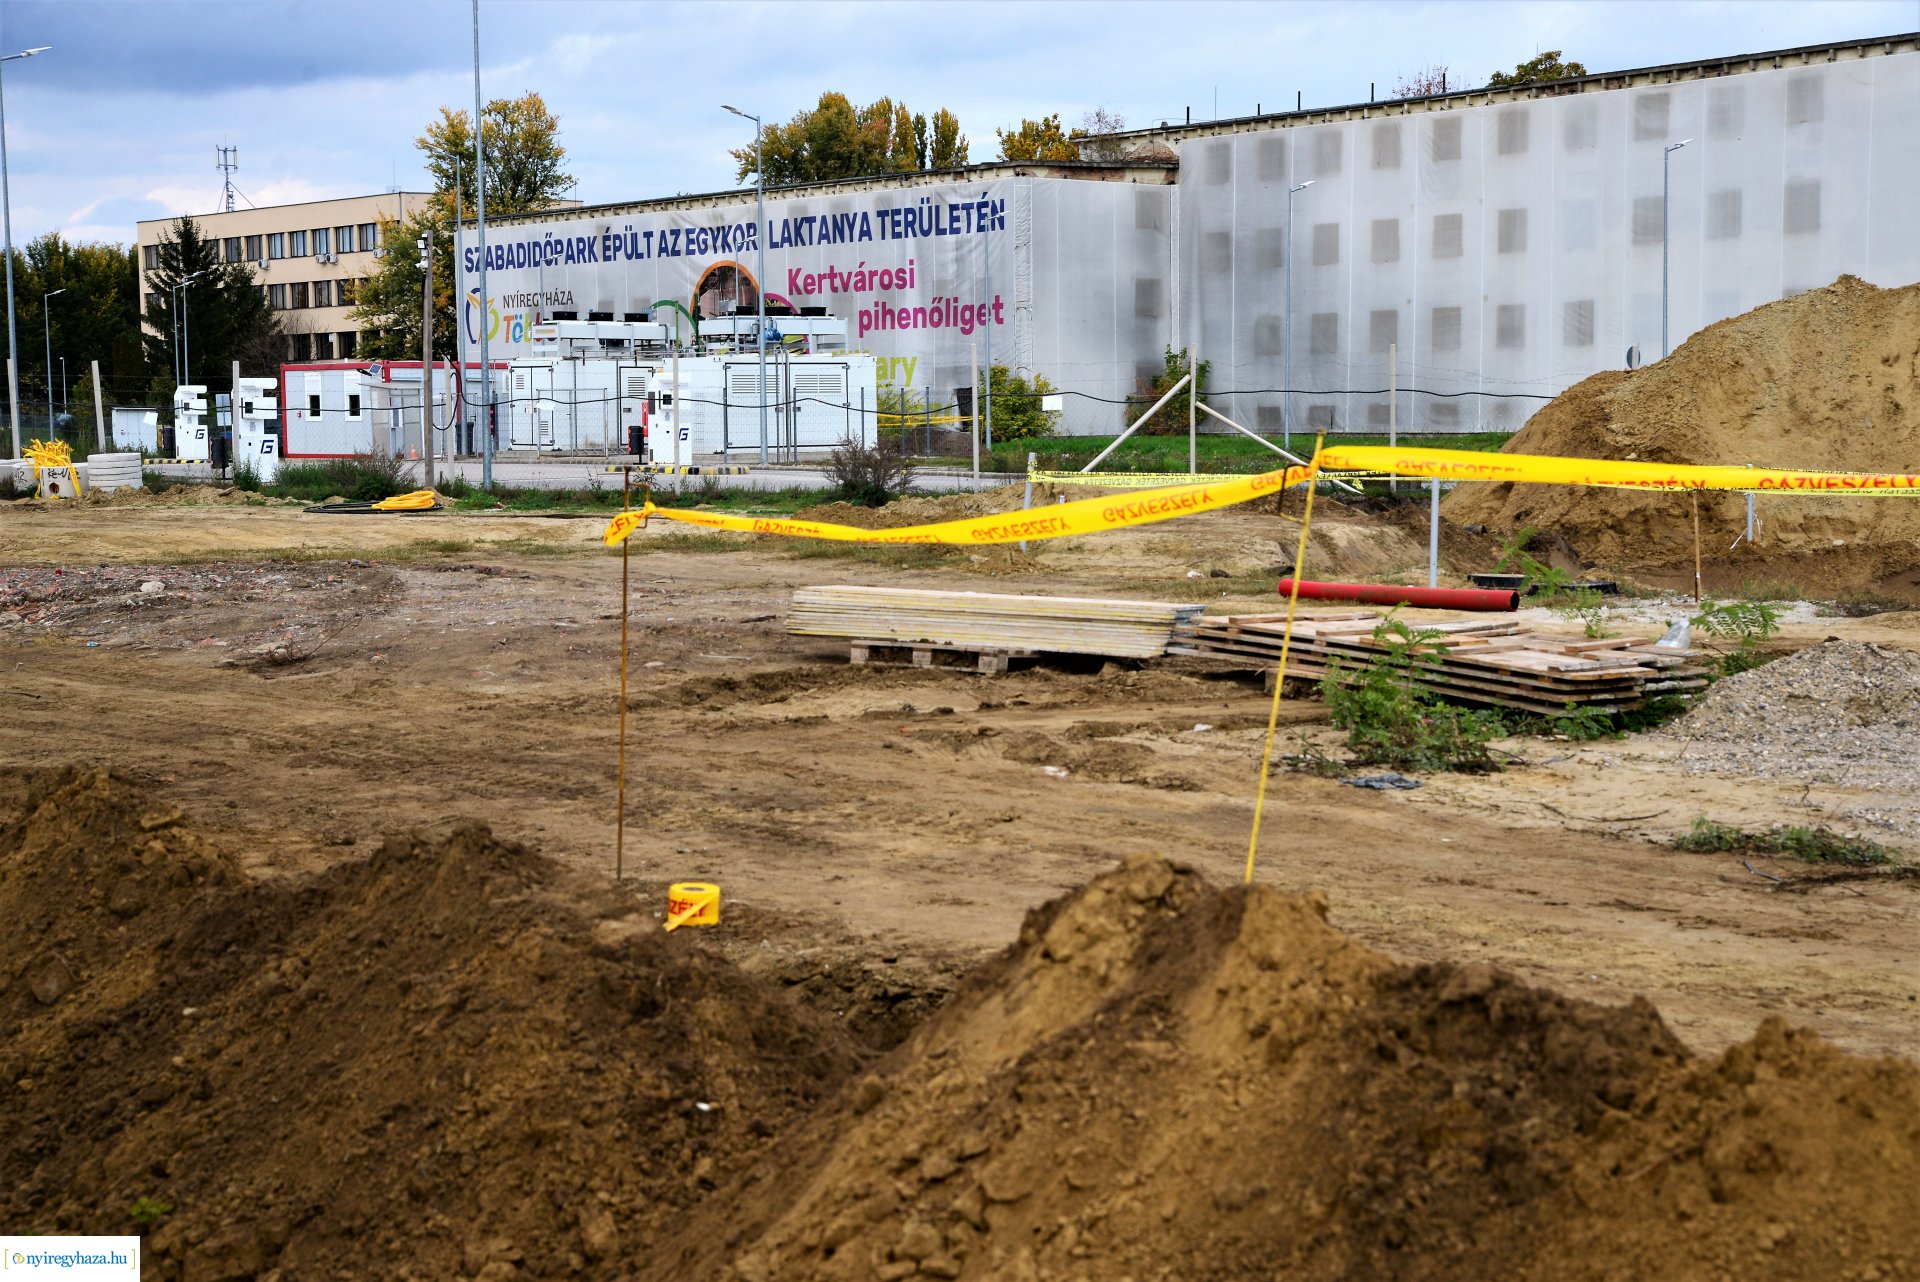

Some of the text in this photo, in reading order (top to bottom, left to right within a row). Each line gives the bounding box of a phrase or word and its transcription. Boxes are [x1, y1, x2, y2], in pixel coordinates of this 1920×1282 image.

[602, 224, 654, 262] ÉPÜLT
[658, 228, 681, 258] AZ
[685, 222, 758, 256] EGYKOR
[768, 211, 873, 249] LAKTANYA
[876, 191, 1005, 239] TERÜLETÉN
[788, 258, 915, 296] Kertvárosi
[503, 288, 574, 309] NYÍREGYHÁZA
[858, 294, 1004, 338] pihenőliget
